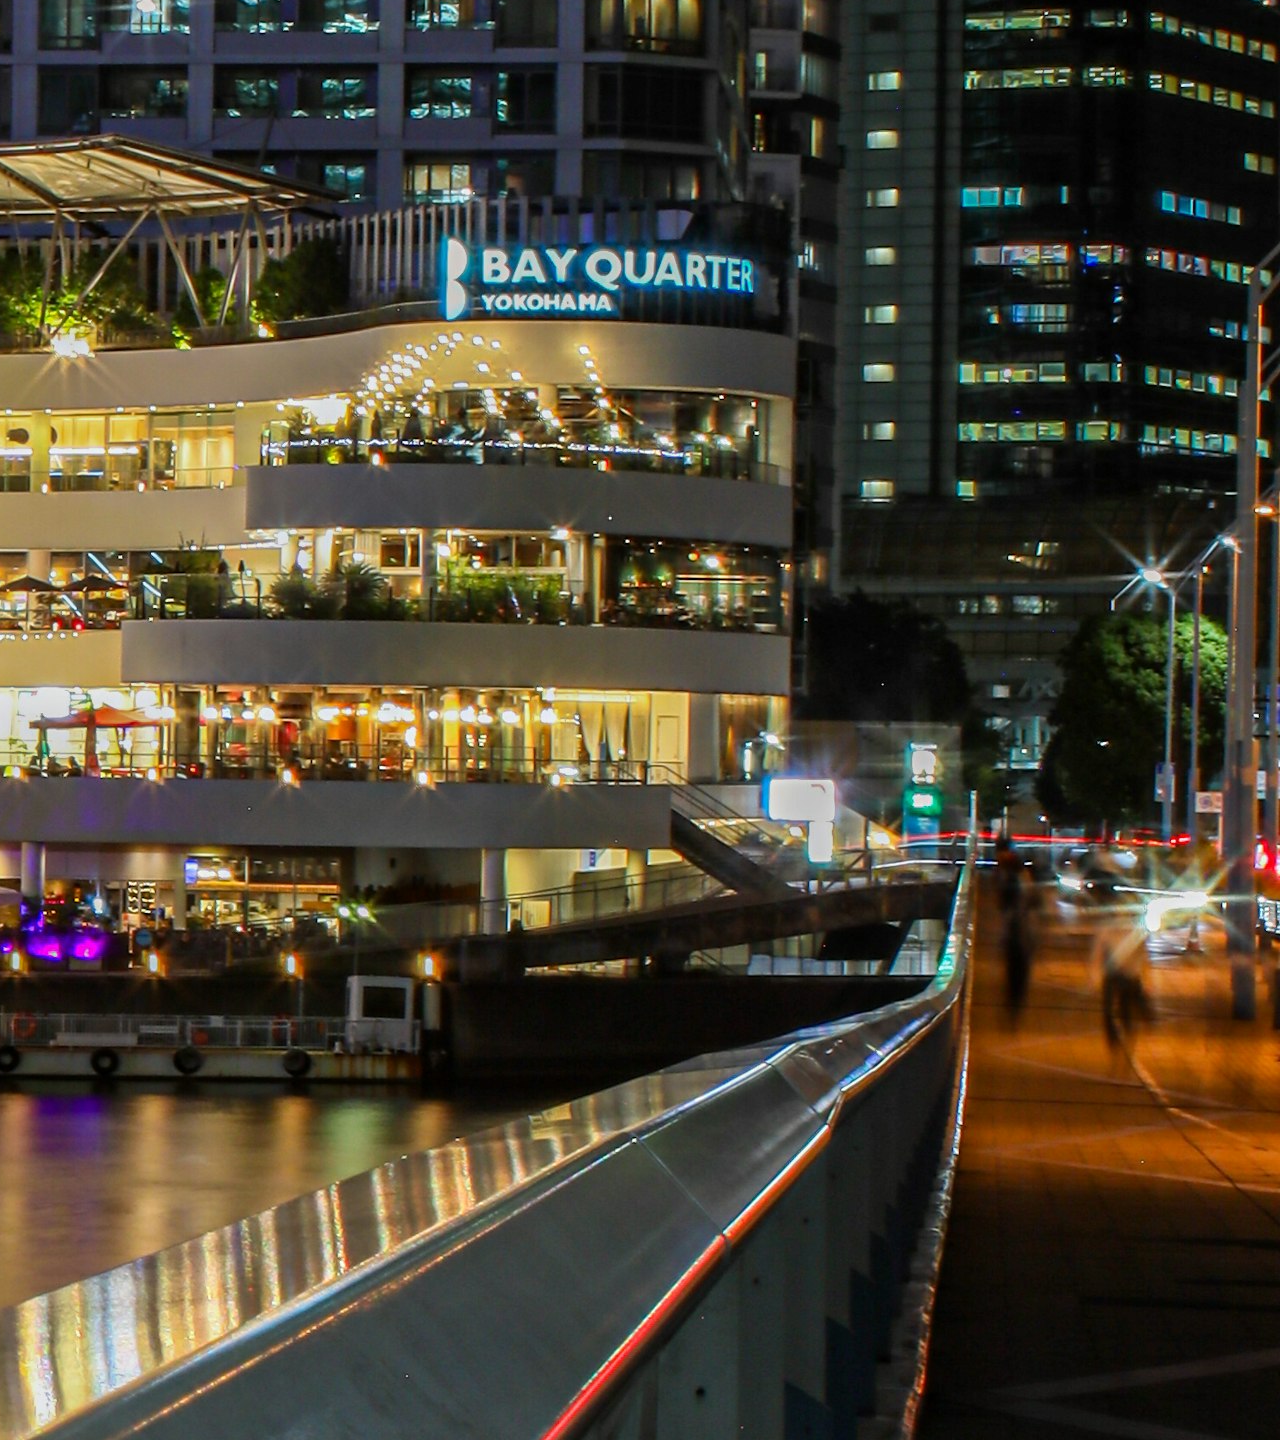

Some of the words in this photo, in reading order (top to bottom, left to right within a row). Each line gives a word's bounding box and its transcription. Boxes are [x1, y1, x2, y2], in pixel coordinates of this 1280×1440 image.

[482, 248, 577, 284] BAY
[585, 249, 754, 293] QUARTER
[482, 293, 612, 312] YOKOHAMA
